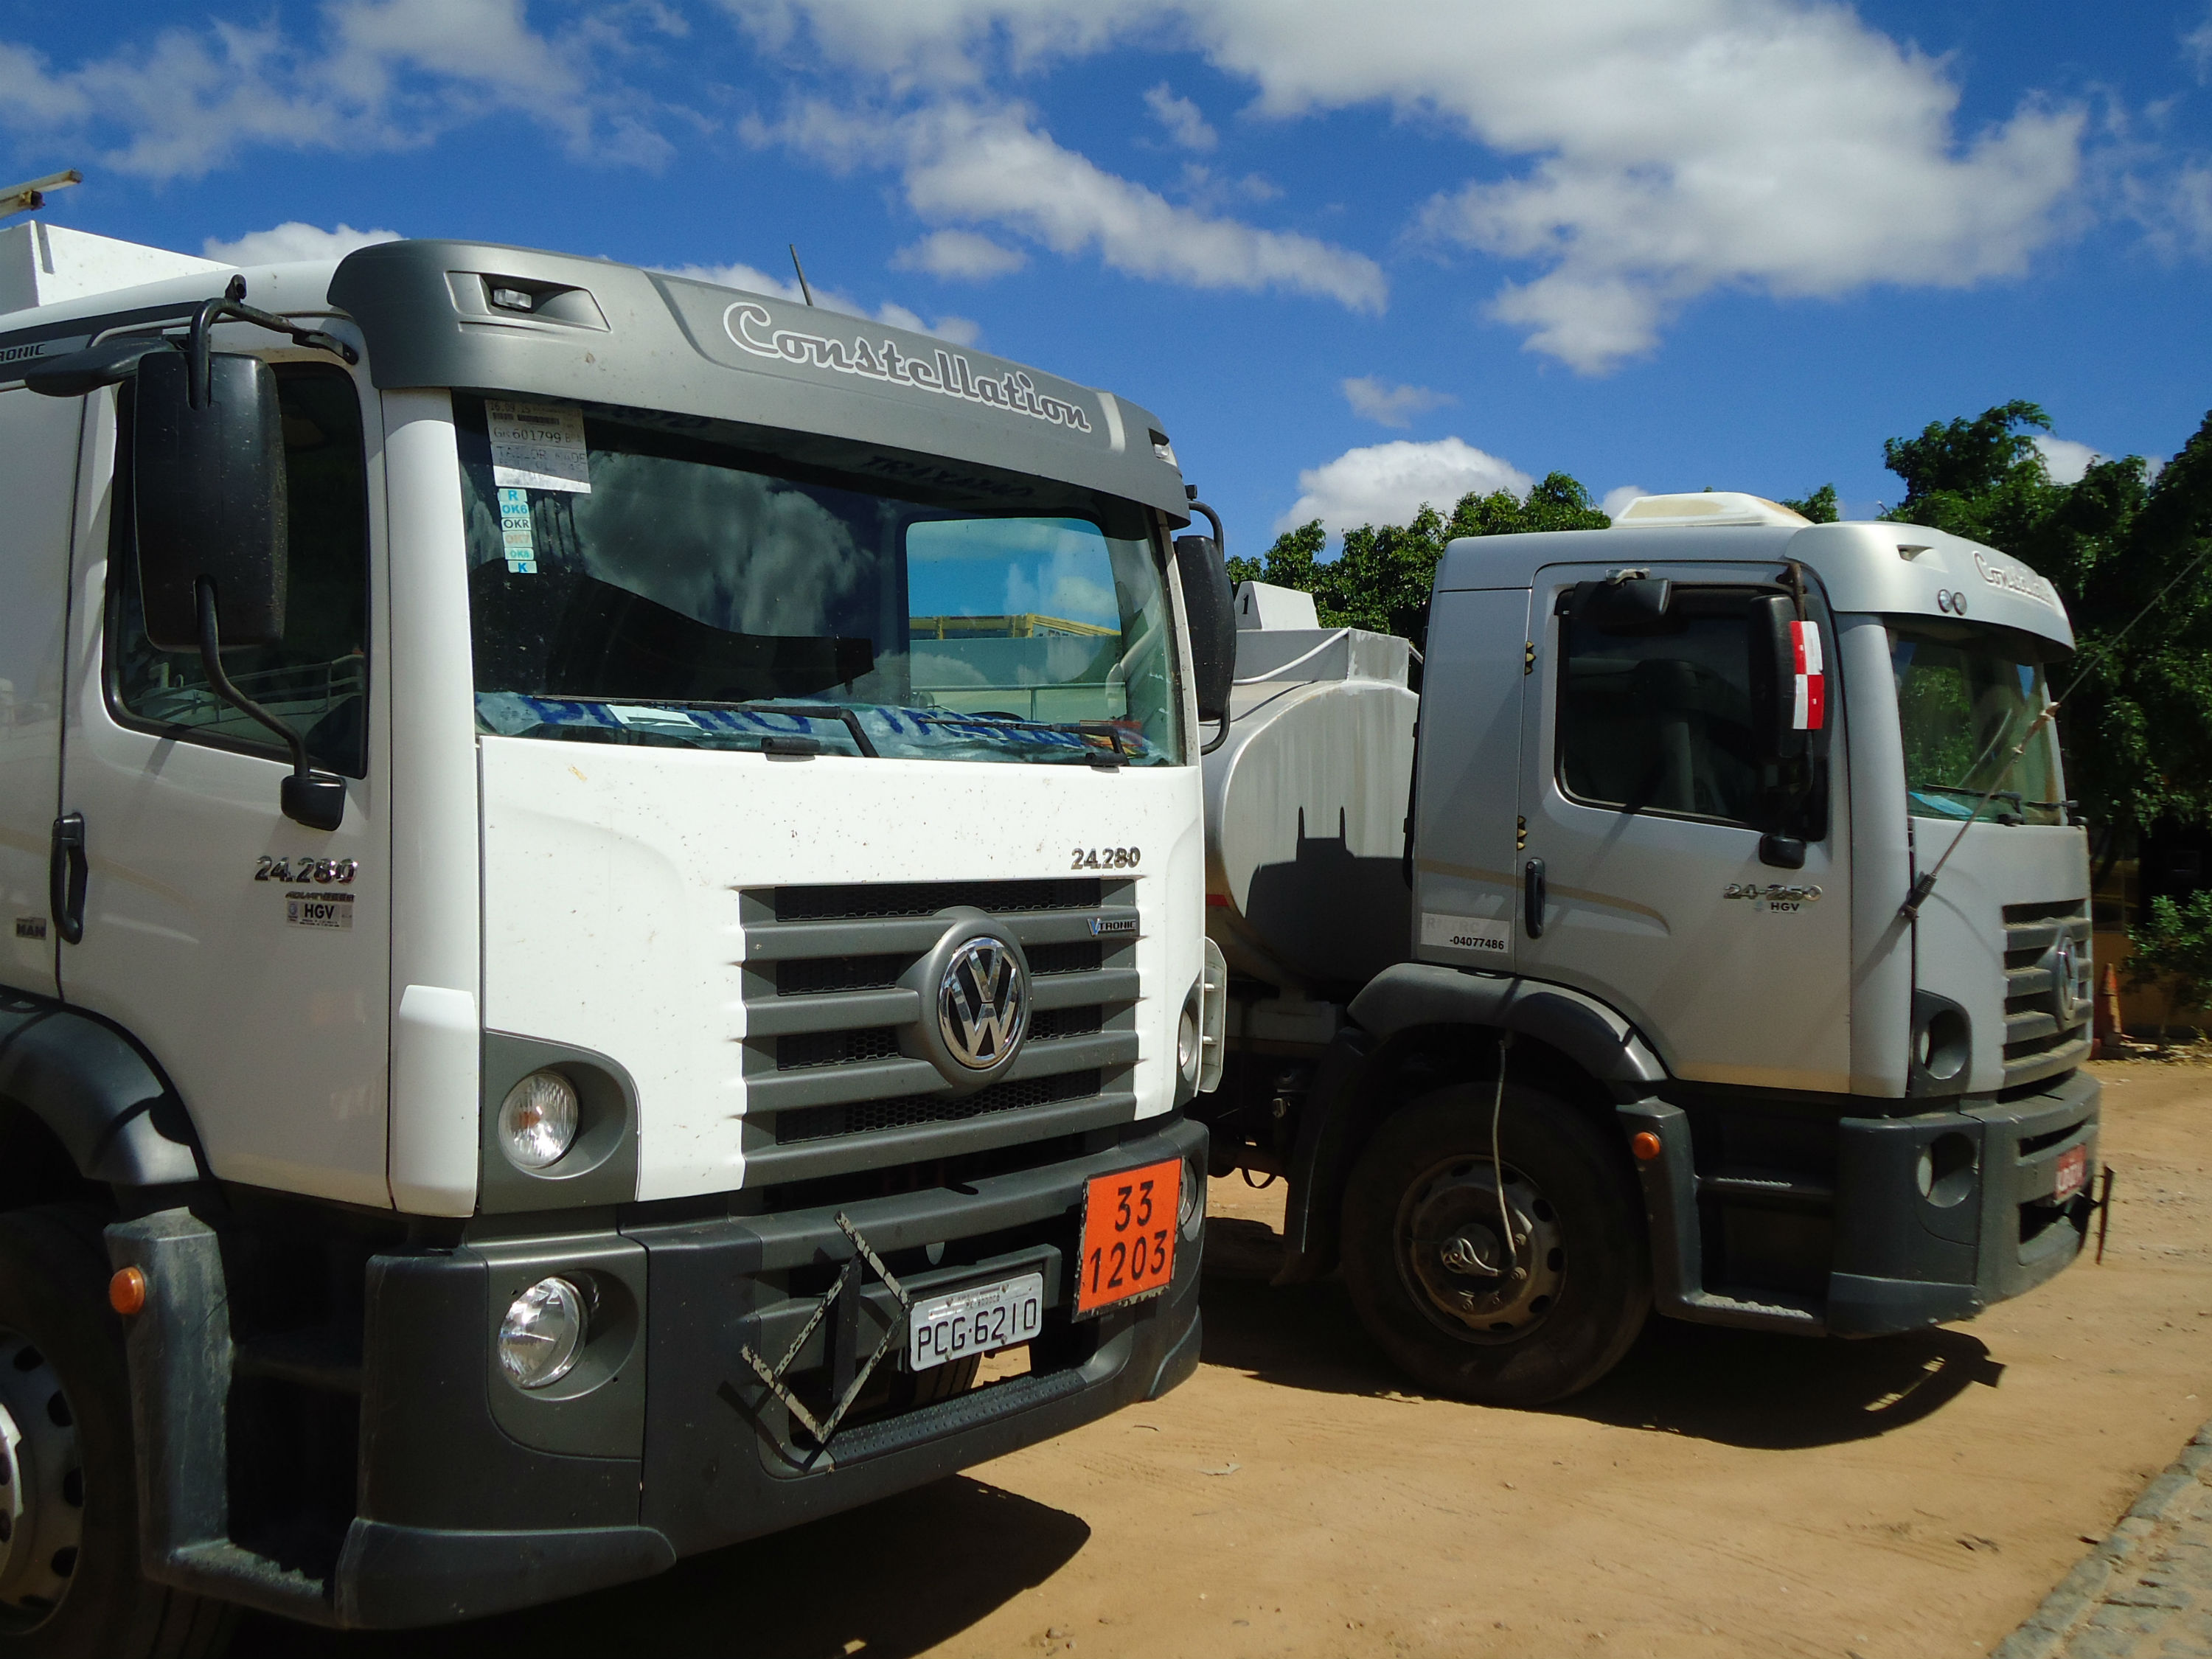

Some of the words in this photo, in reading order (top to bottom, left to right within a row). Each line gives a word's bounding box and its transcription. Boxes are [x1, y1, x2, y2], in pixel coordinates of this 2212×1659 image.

[723, 302, 1091, 433] Constellation
[502, 504, 528, 514] OK6
[504, 519, 529, 529] OKR
[1071, 846, 1141, 869] 24.280
[254, 855, 358, 885] 24.280
[305, 903, 335, 919] HGV
[1771, 902, 1800, 911] HGV
[1425, 917, 1481, 933] RTRC
[1115, 1180, 1154, 1232] 33
[1091, 1229, 1167, 1294] 1203
